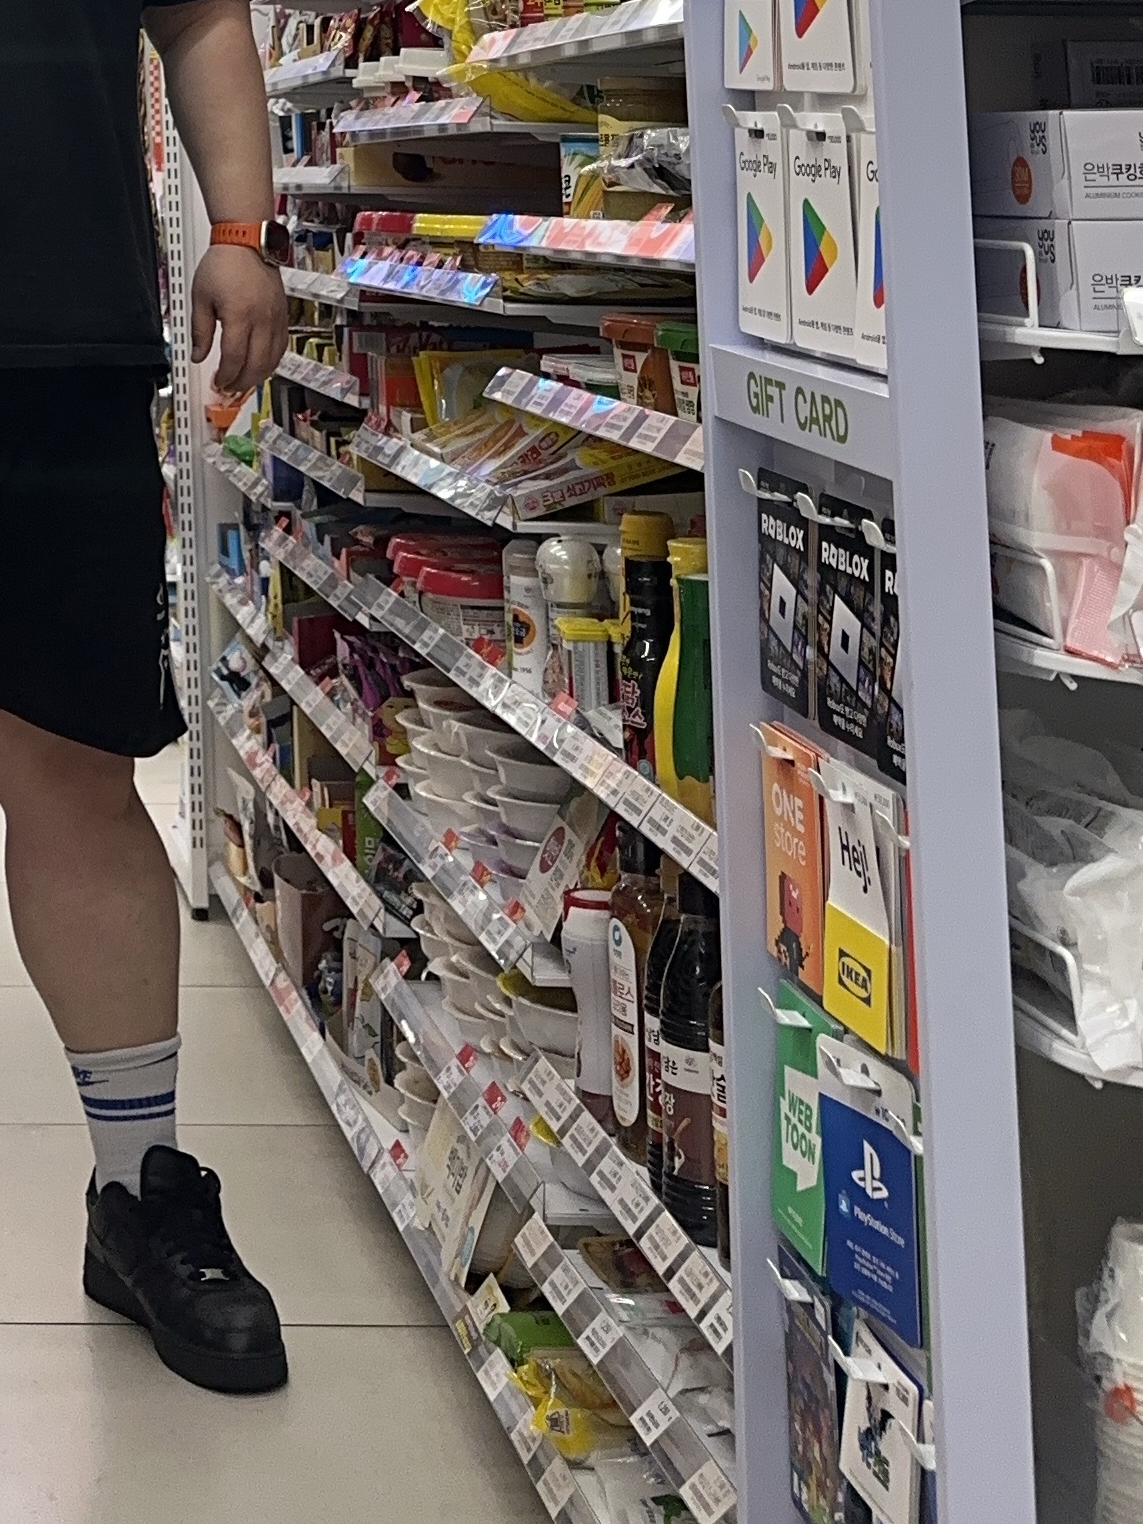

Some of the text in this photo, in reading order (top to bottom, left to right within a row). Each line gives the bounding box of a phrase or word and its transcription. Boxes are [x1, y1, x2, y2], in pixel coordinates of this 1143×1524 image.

[739, 151, 777, 179] Google Play
[793, 155, 822, 183] Google
[823, 158, 842, 185] Play
[746, 371, 849, 445] GIFT CARD
[761, 512, 805, 552] ROBLOX
[821, 541, 870, 582] ROBLOX
[771, 782, 805, 834] ONE
[774, 828, 807, 867] store
[838, 826, 872, 894] Hej!
[841, 960, 869, 992] IKEA
[787, 1089, 814, 1133] WEB
[784, 1113, 817, 1166] TOON
